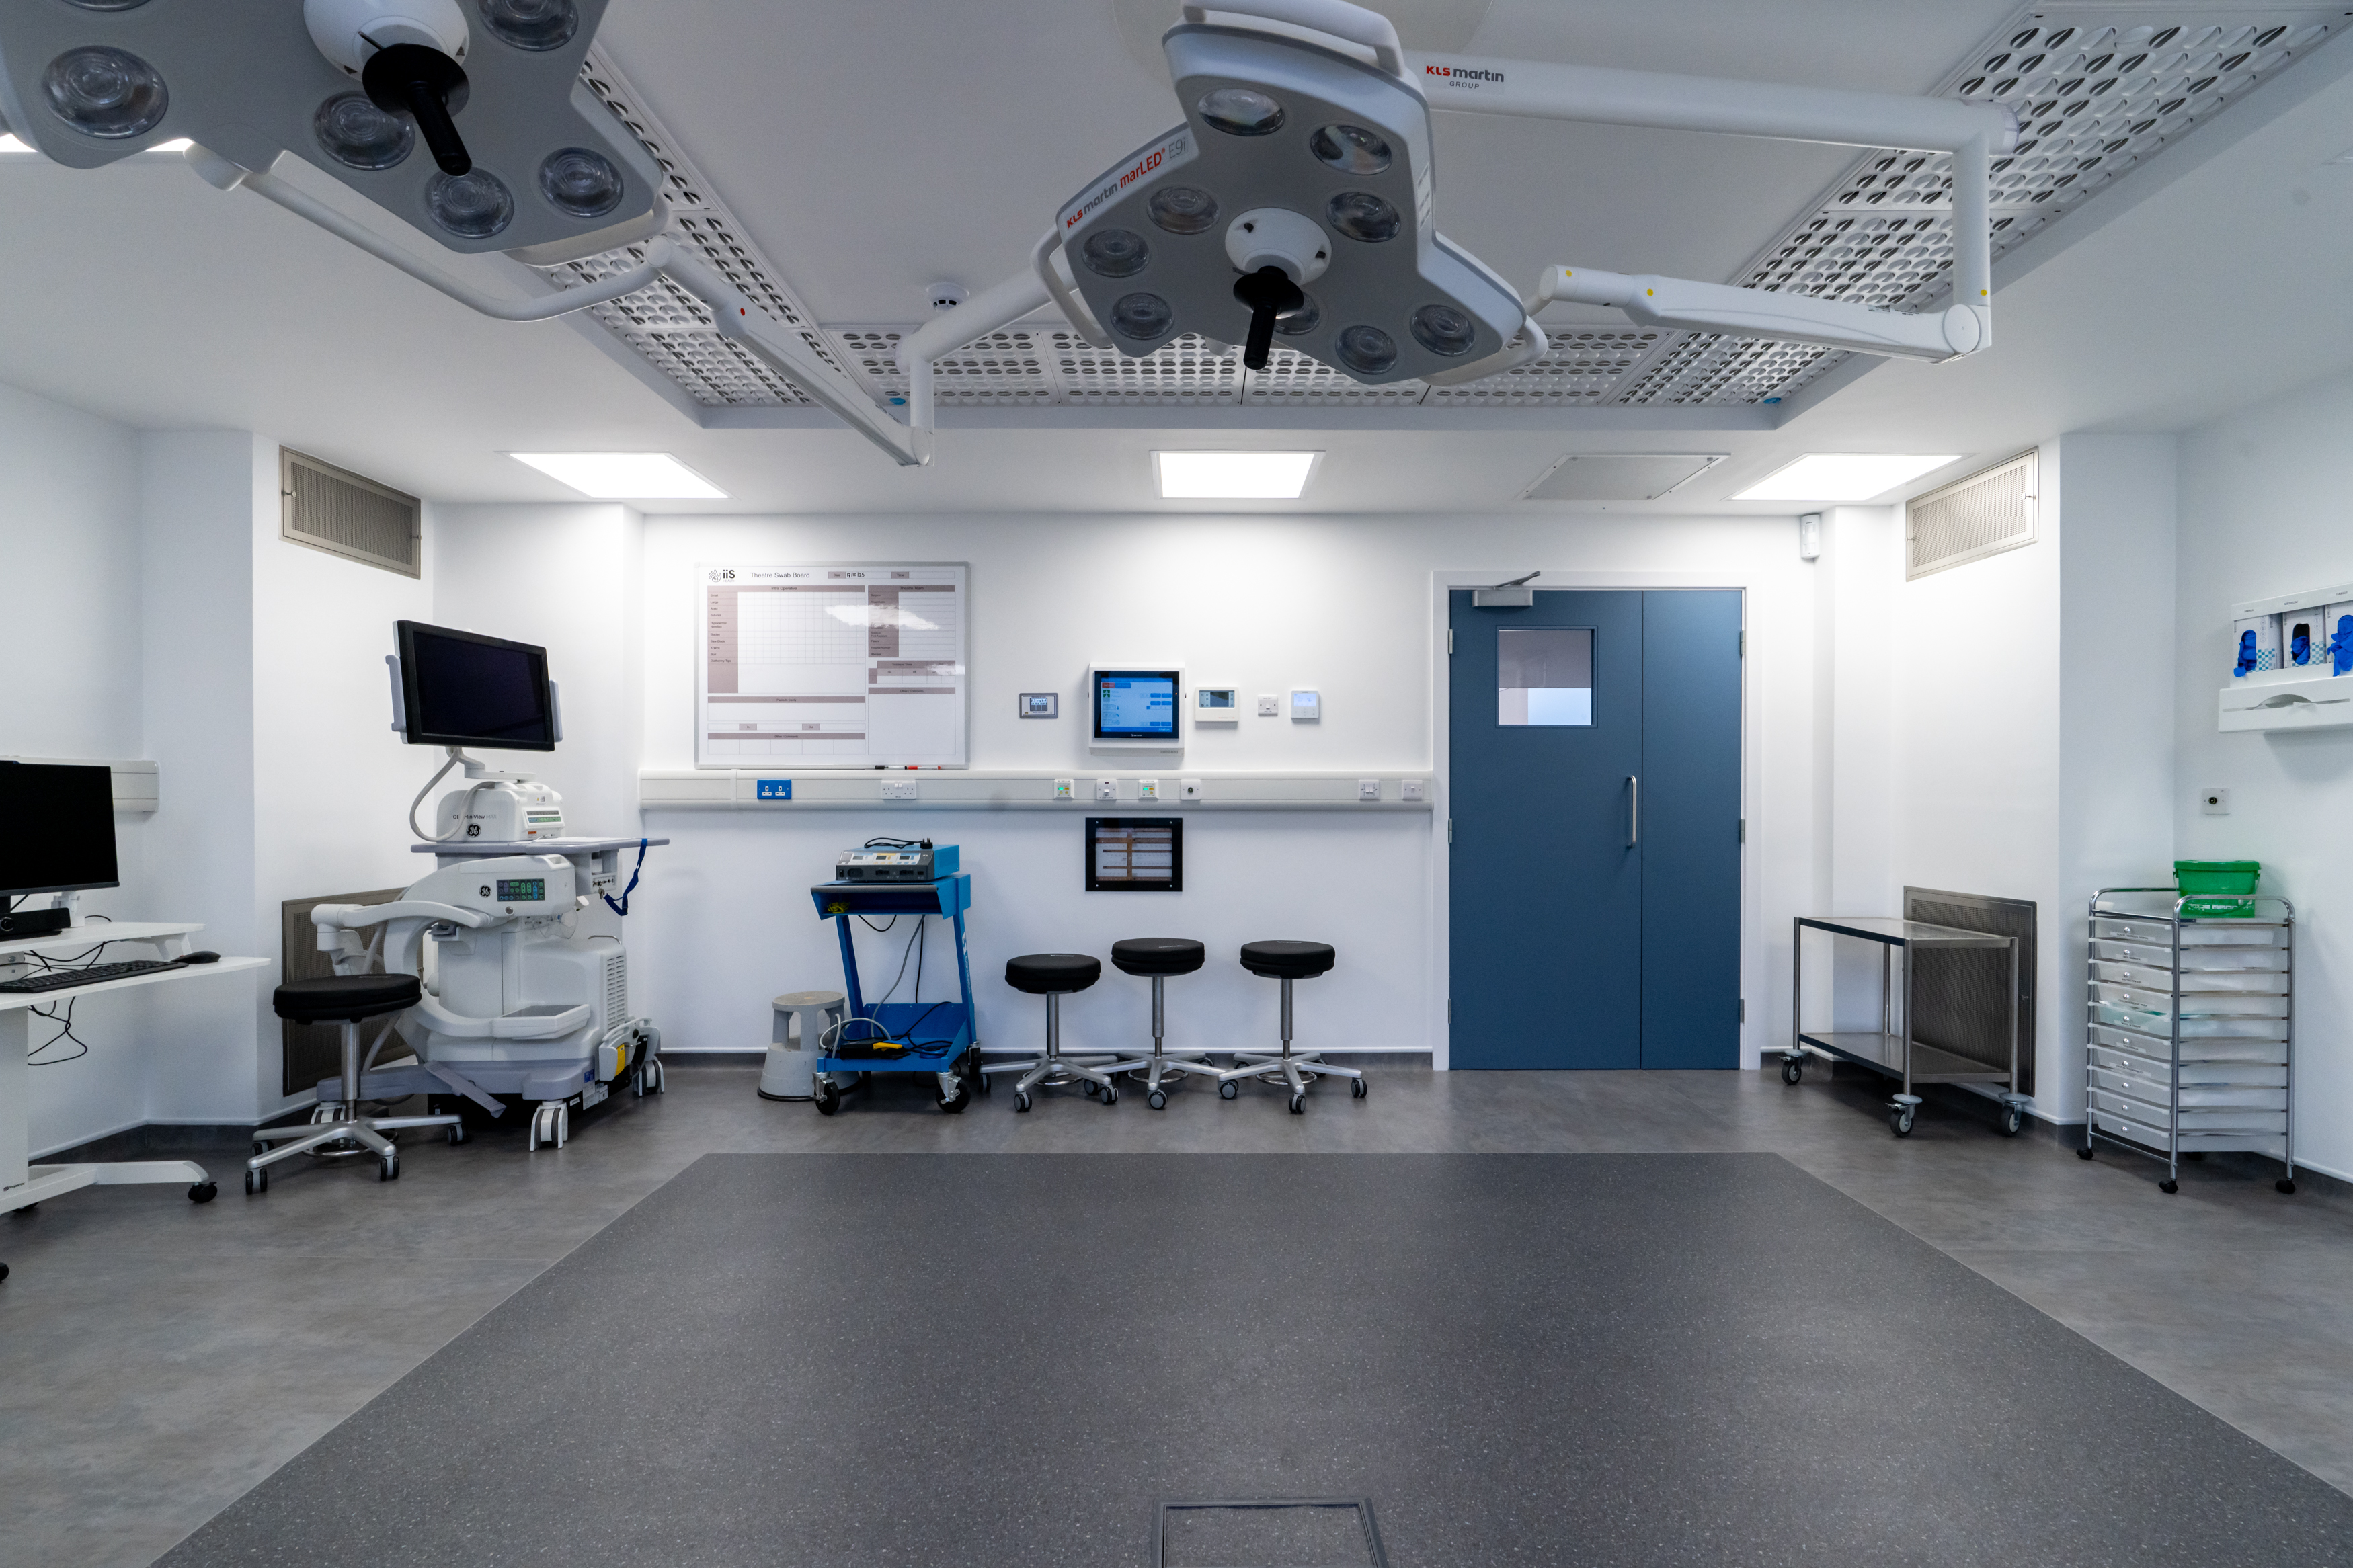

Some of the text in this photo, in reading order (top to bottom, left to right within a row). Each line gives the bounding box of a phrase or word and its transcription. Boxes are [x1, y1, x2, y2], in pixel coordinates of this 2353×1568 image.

[1426, 65, 1505, 83] KLS martin
[1449, 80, 1480, 89] GROUP
[1066, 209, 1084, 229] KLS
[1083, 183, 1118, 215] martin
[1168, 137, 1187, 159] E9i
